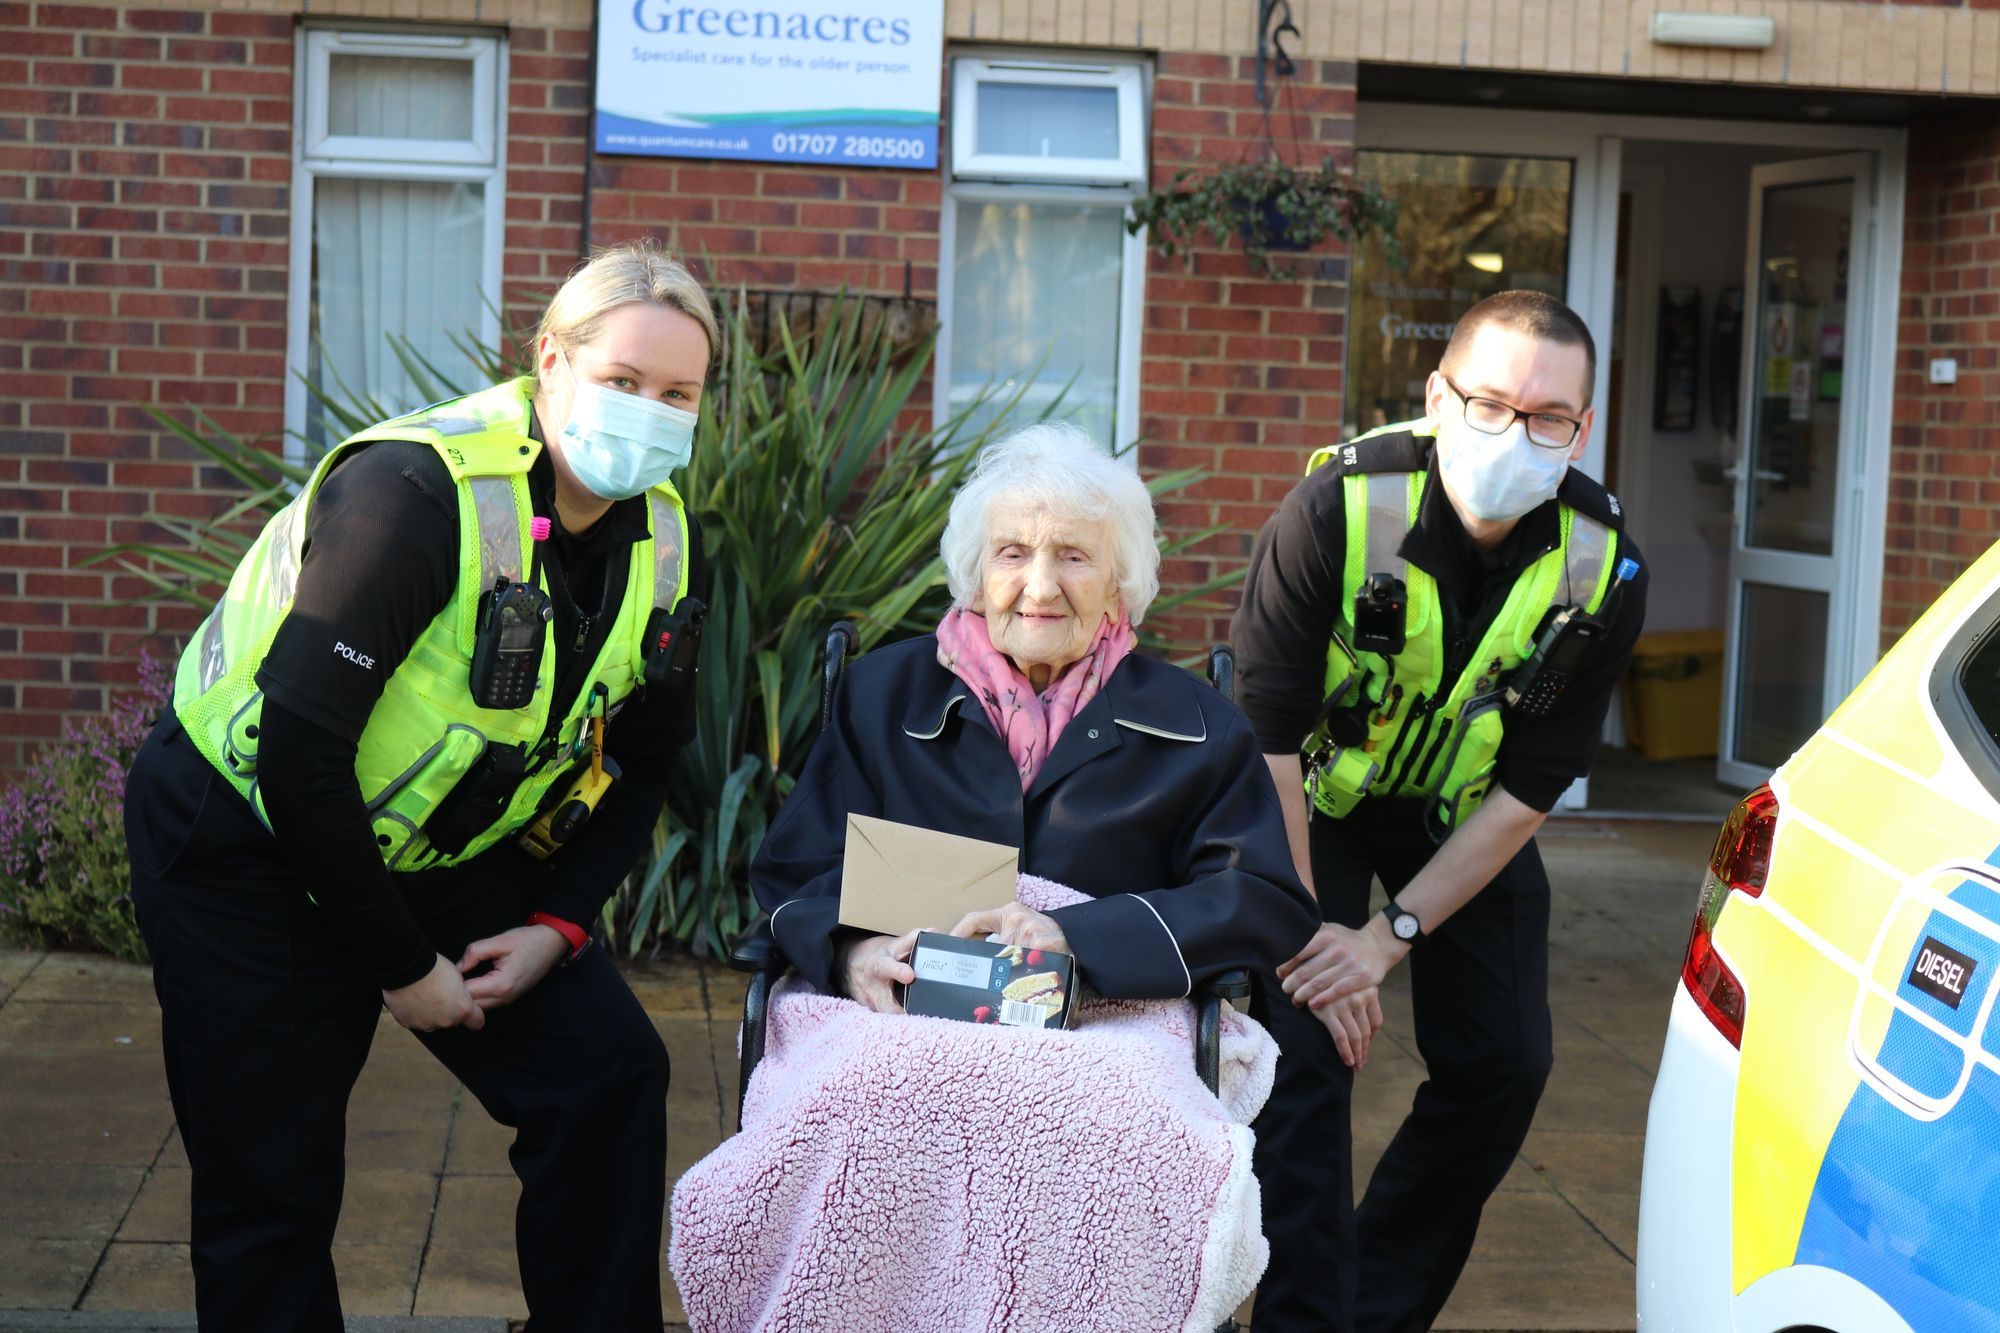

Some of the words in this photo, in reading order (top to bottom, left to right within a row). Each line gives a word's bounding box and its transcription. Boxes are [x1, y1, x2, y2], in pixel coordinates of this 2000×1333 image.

[632, 0, 911, 45] Greenacres
[632, 47, 706, 63] Specialist
[712, 52, 745, 66] care
[750, 52, 773, 67] for
[778, 54, 803, 69] the
[809, 56, 850, 71] older
[855, 60, 911, 74] person
[772, 132, 837, 155] 01707
[843, 138, 925, 159] 280500
[333, 641, 375, 670] POLICE
[1916, 948, 1965, 994] DIESEL
